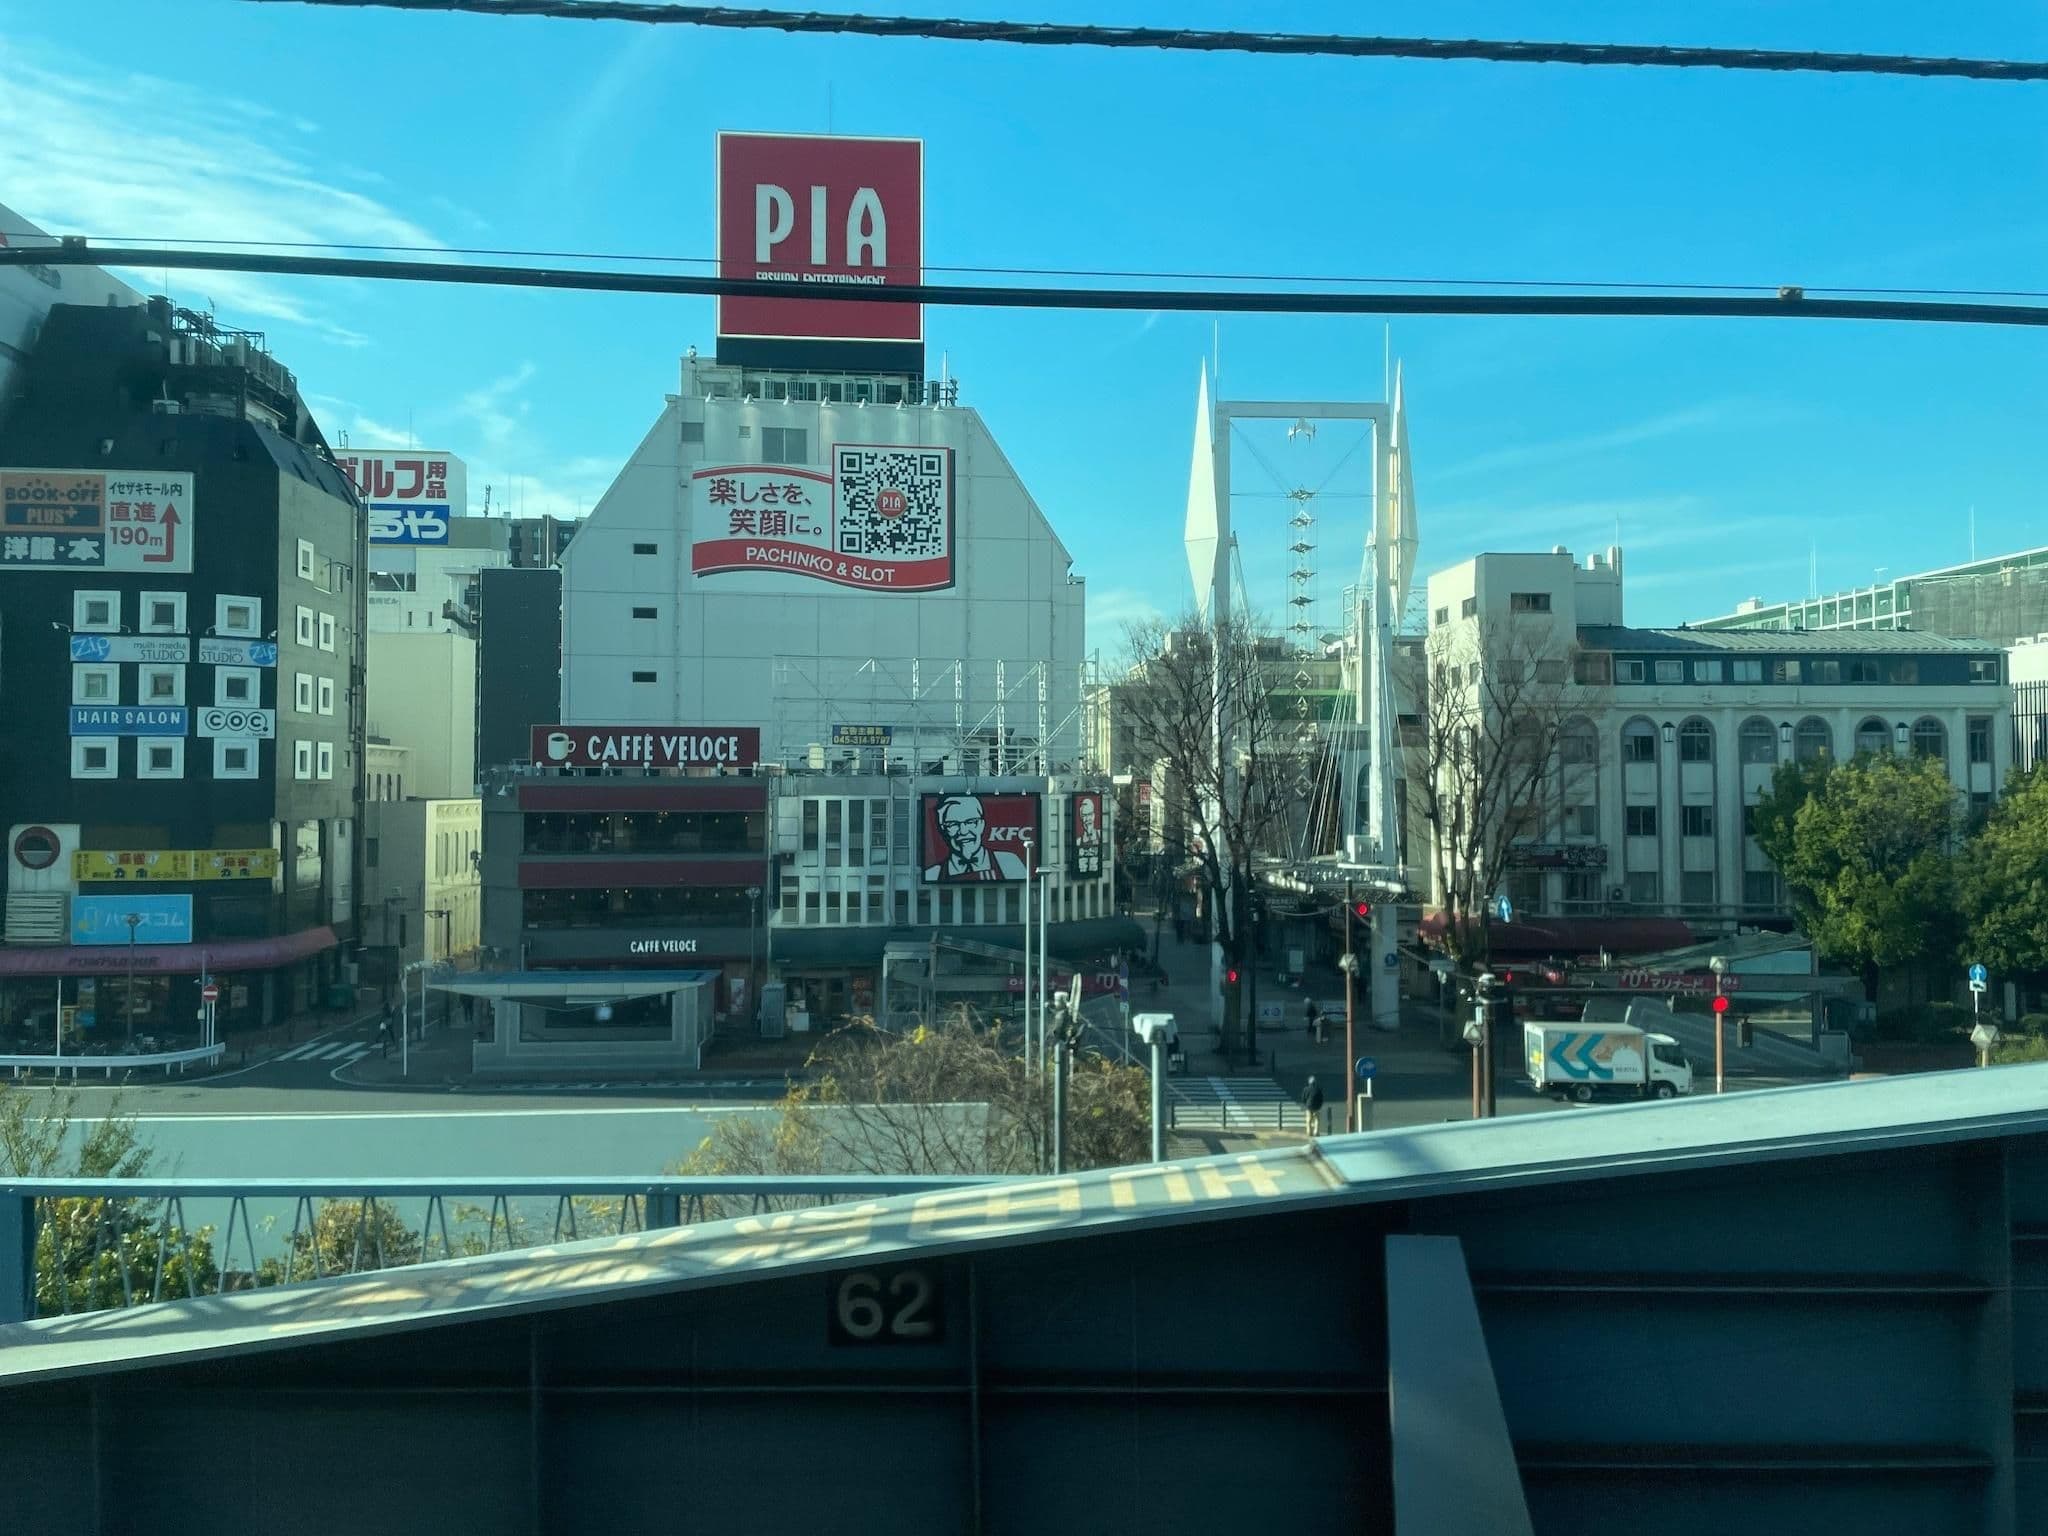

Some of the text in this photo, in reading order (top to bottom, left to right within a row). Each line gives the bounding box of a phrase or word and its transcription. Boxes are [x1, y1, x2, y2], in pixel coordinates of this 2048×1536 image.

[755, 183, 887, 267] PIA
[109, 481, 183, 497] イセザキモール内
[709, 478, 812, 505] 楽しさを、
[882, 496, 901, 508] PIA
[109, 502, 157, 522] 直進
[728, 508, 823, 536] 笑顔に。
[109, 526, 163, 547] 190m
[745, 546, 896, 583] PACHINKO & SLOT
[140, 649, 186, 662] STUDIO
[200, 651, 244, 664] STUDIO
[77, 711, 181, 725] HAIR SALON
[660, 736, 738, 762] VELOCE
[988, 827, 1034, 842] KFC
[104, 911, 185, 928] ハスコム
[662, 940, 697, 953] VELOCE
[838, 1269, 934, 1338] 62
